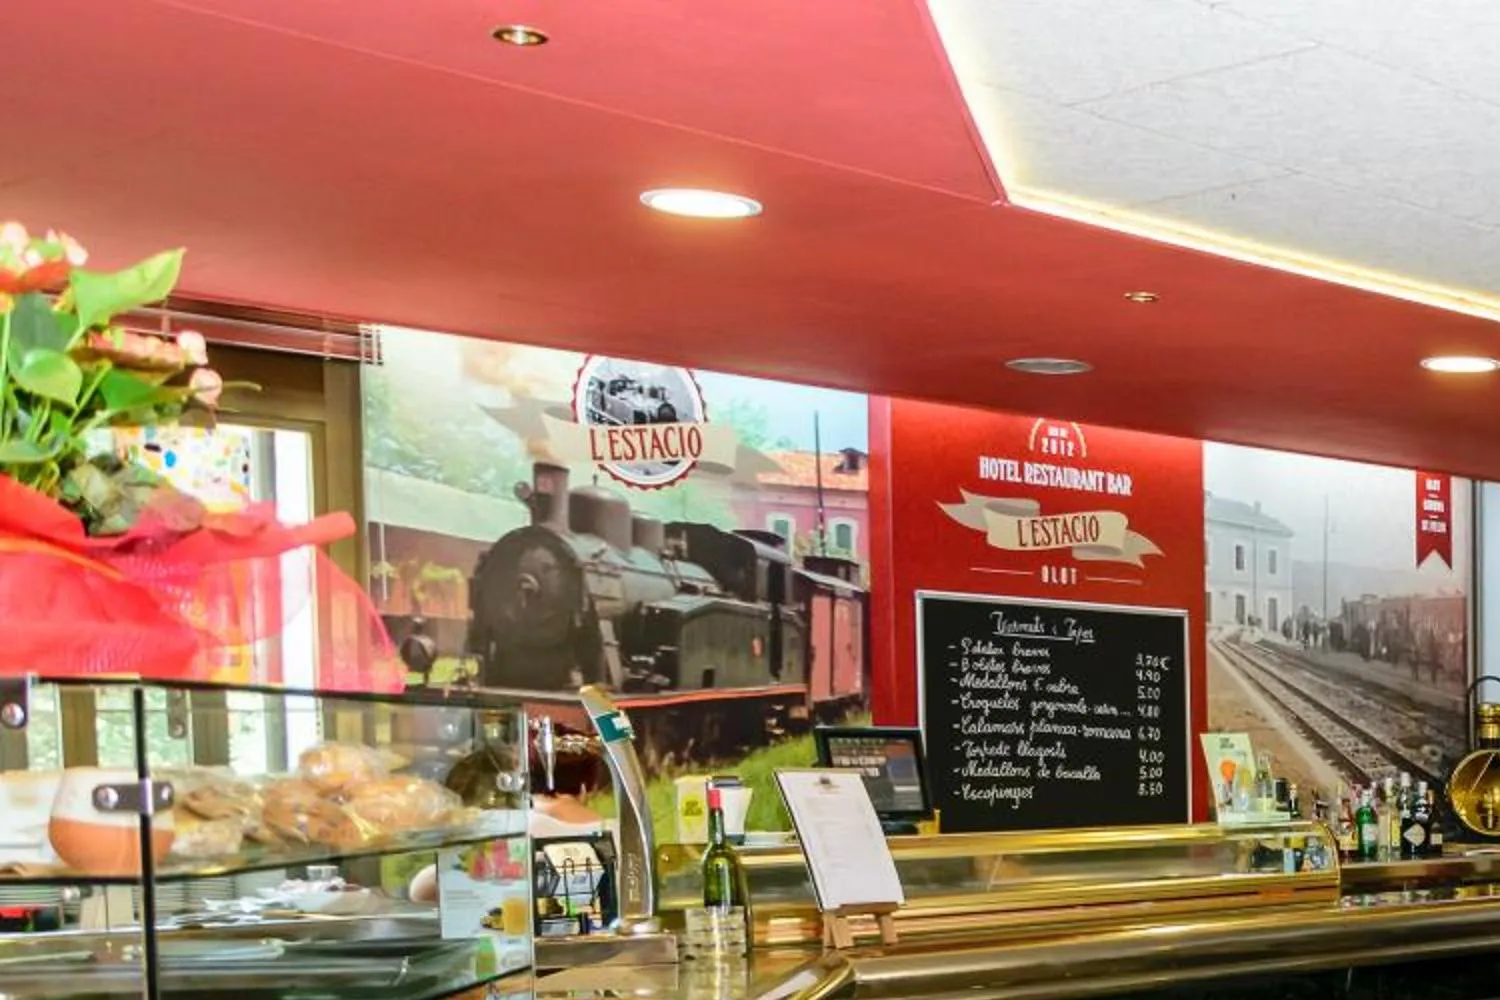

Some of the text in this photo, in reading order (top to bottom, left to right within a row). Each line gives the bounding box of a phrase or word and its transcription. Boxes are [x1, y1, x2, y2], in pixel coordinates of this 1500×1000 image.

[979, 456, 1133, 497] HOTEL RESTAURANT BAR
[1041, 565, 1078, 585] OLOT
